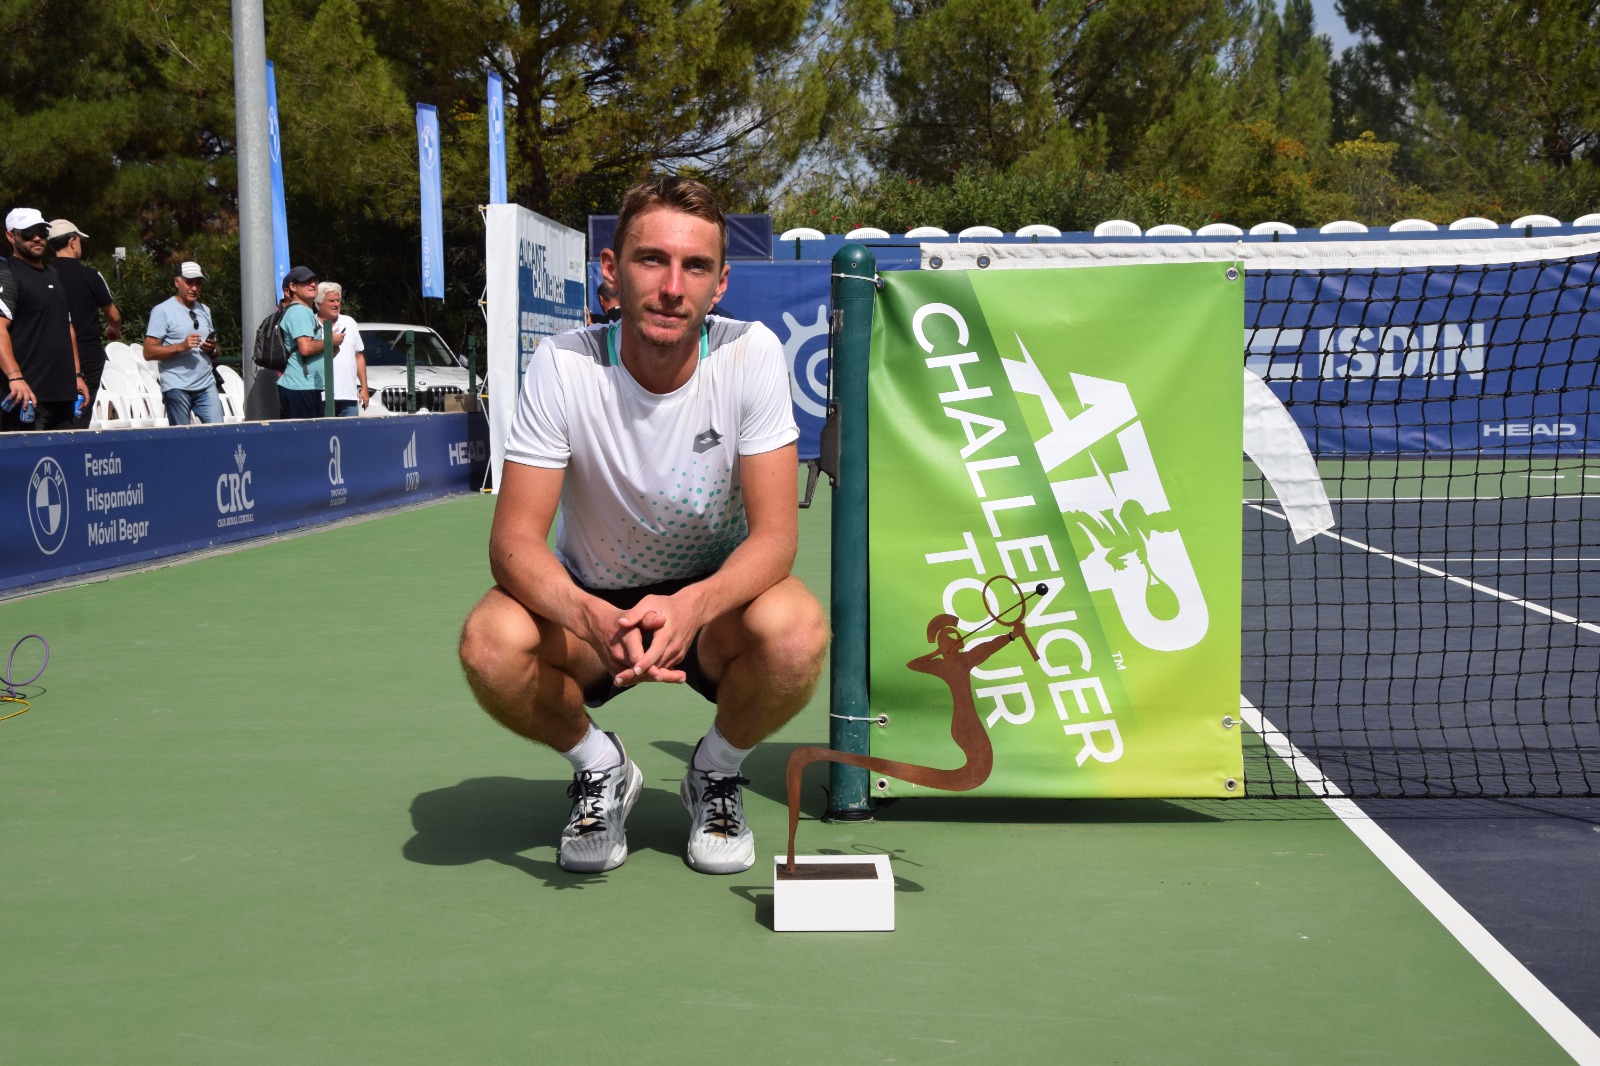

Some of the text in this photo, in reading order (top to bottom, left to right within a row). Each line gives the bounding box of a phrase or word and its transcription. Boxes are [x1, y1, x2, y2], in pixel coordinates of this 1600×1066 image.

[1319, 323, 1486, 382] ISDIN
[1483, 423, 1577, 437] HEAD
[85, 452, 122, 477] Fersán
[449, 440, 486, 466] HEAD
[32, 462, 63, 490] BMW
[86, 482, 144, 515] Hispamóvil
[217, 470, 255, 514] CRC
[88, 518, 150, 547] Móvil Begar
[912, 301, 1125, 767] CHALLENGER
[925, 532, 1037, 729] TOUR
